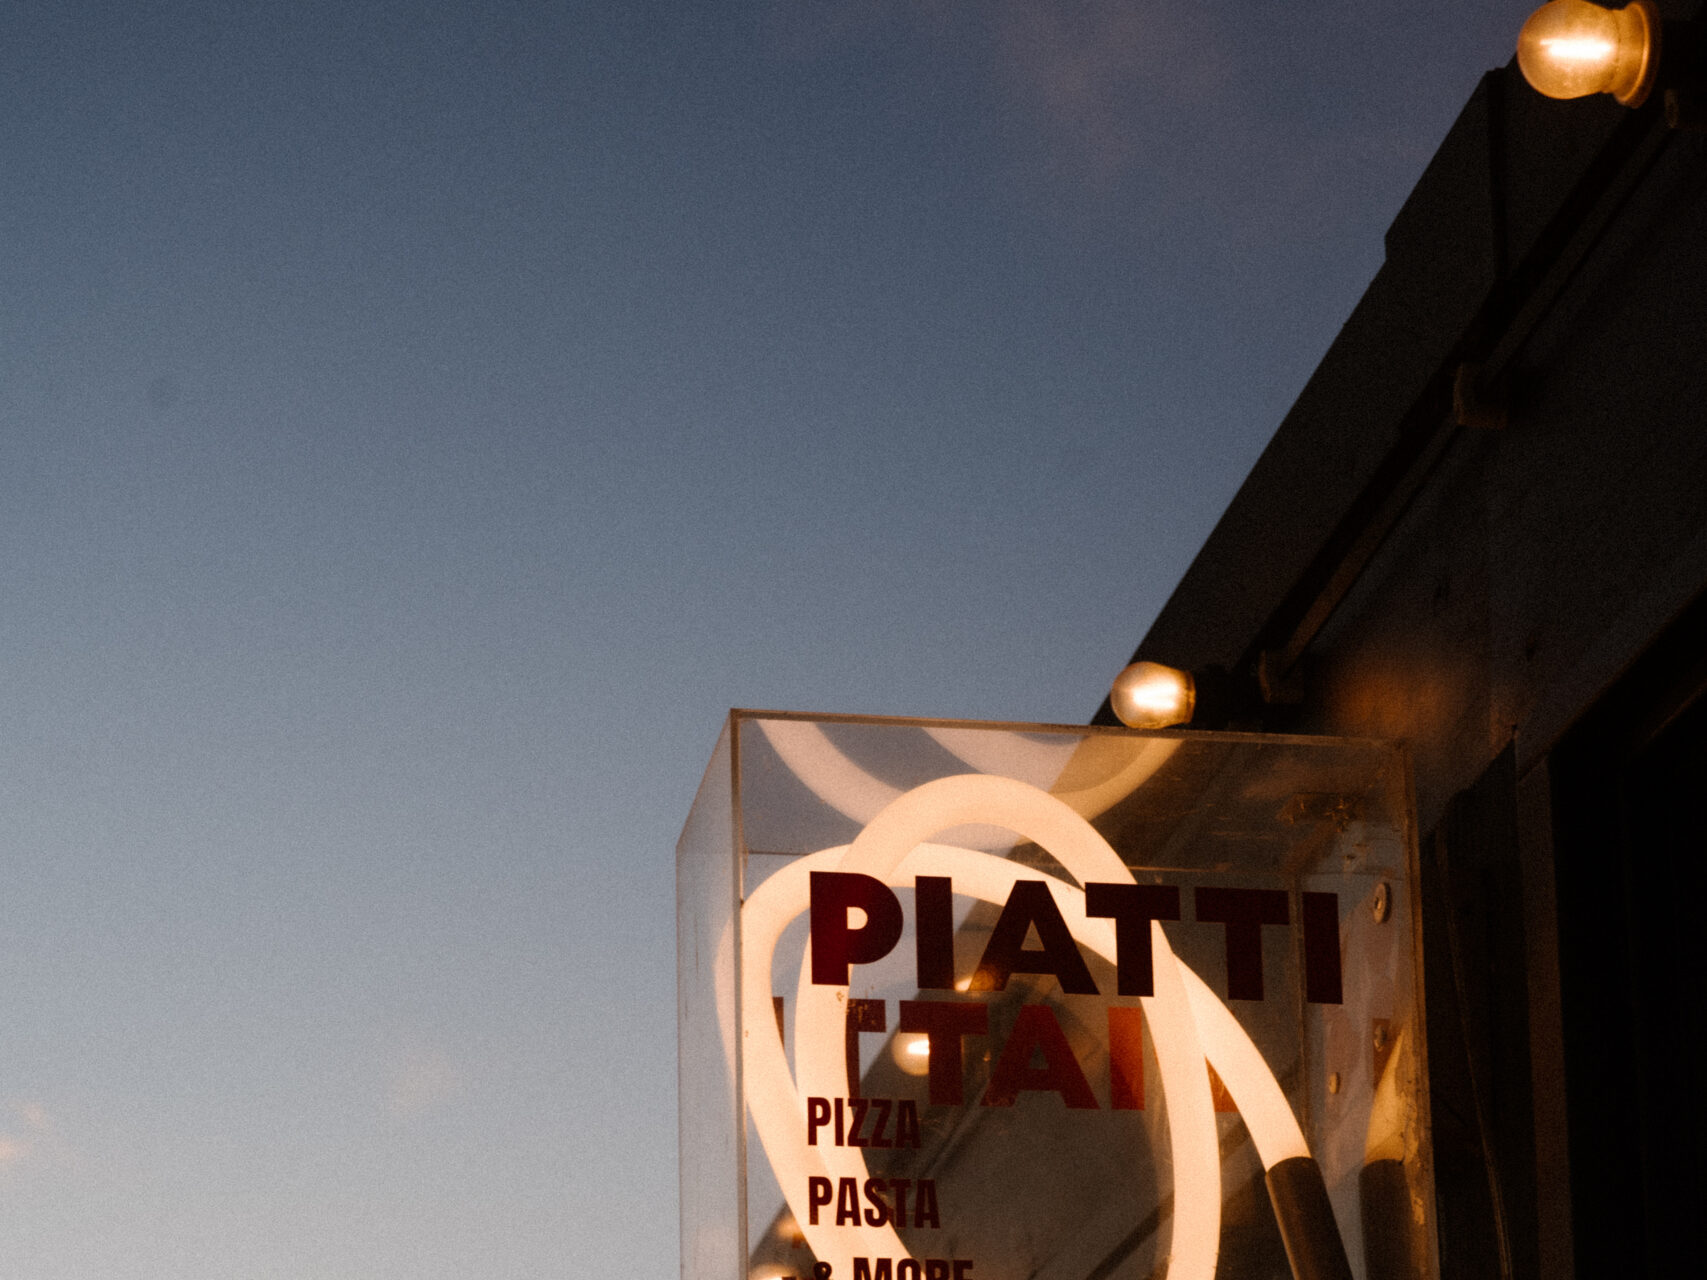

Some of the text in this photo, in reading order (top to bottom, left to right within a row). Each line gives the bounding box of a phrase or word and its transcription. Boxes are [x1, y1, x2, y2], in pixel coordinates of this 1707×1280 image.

[810, 871, 1343, 1005] PIATTI
[807, 1097, 921, 1148] PIZZA
[808, 1176, 940, 1228] PASTA
